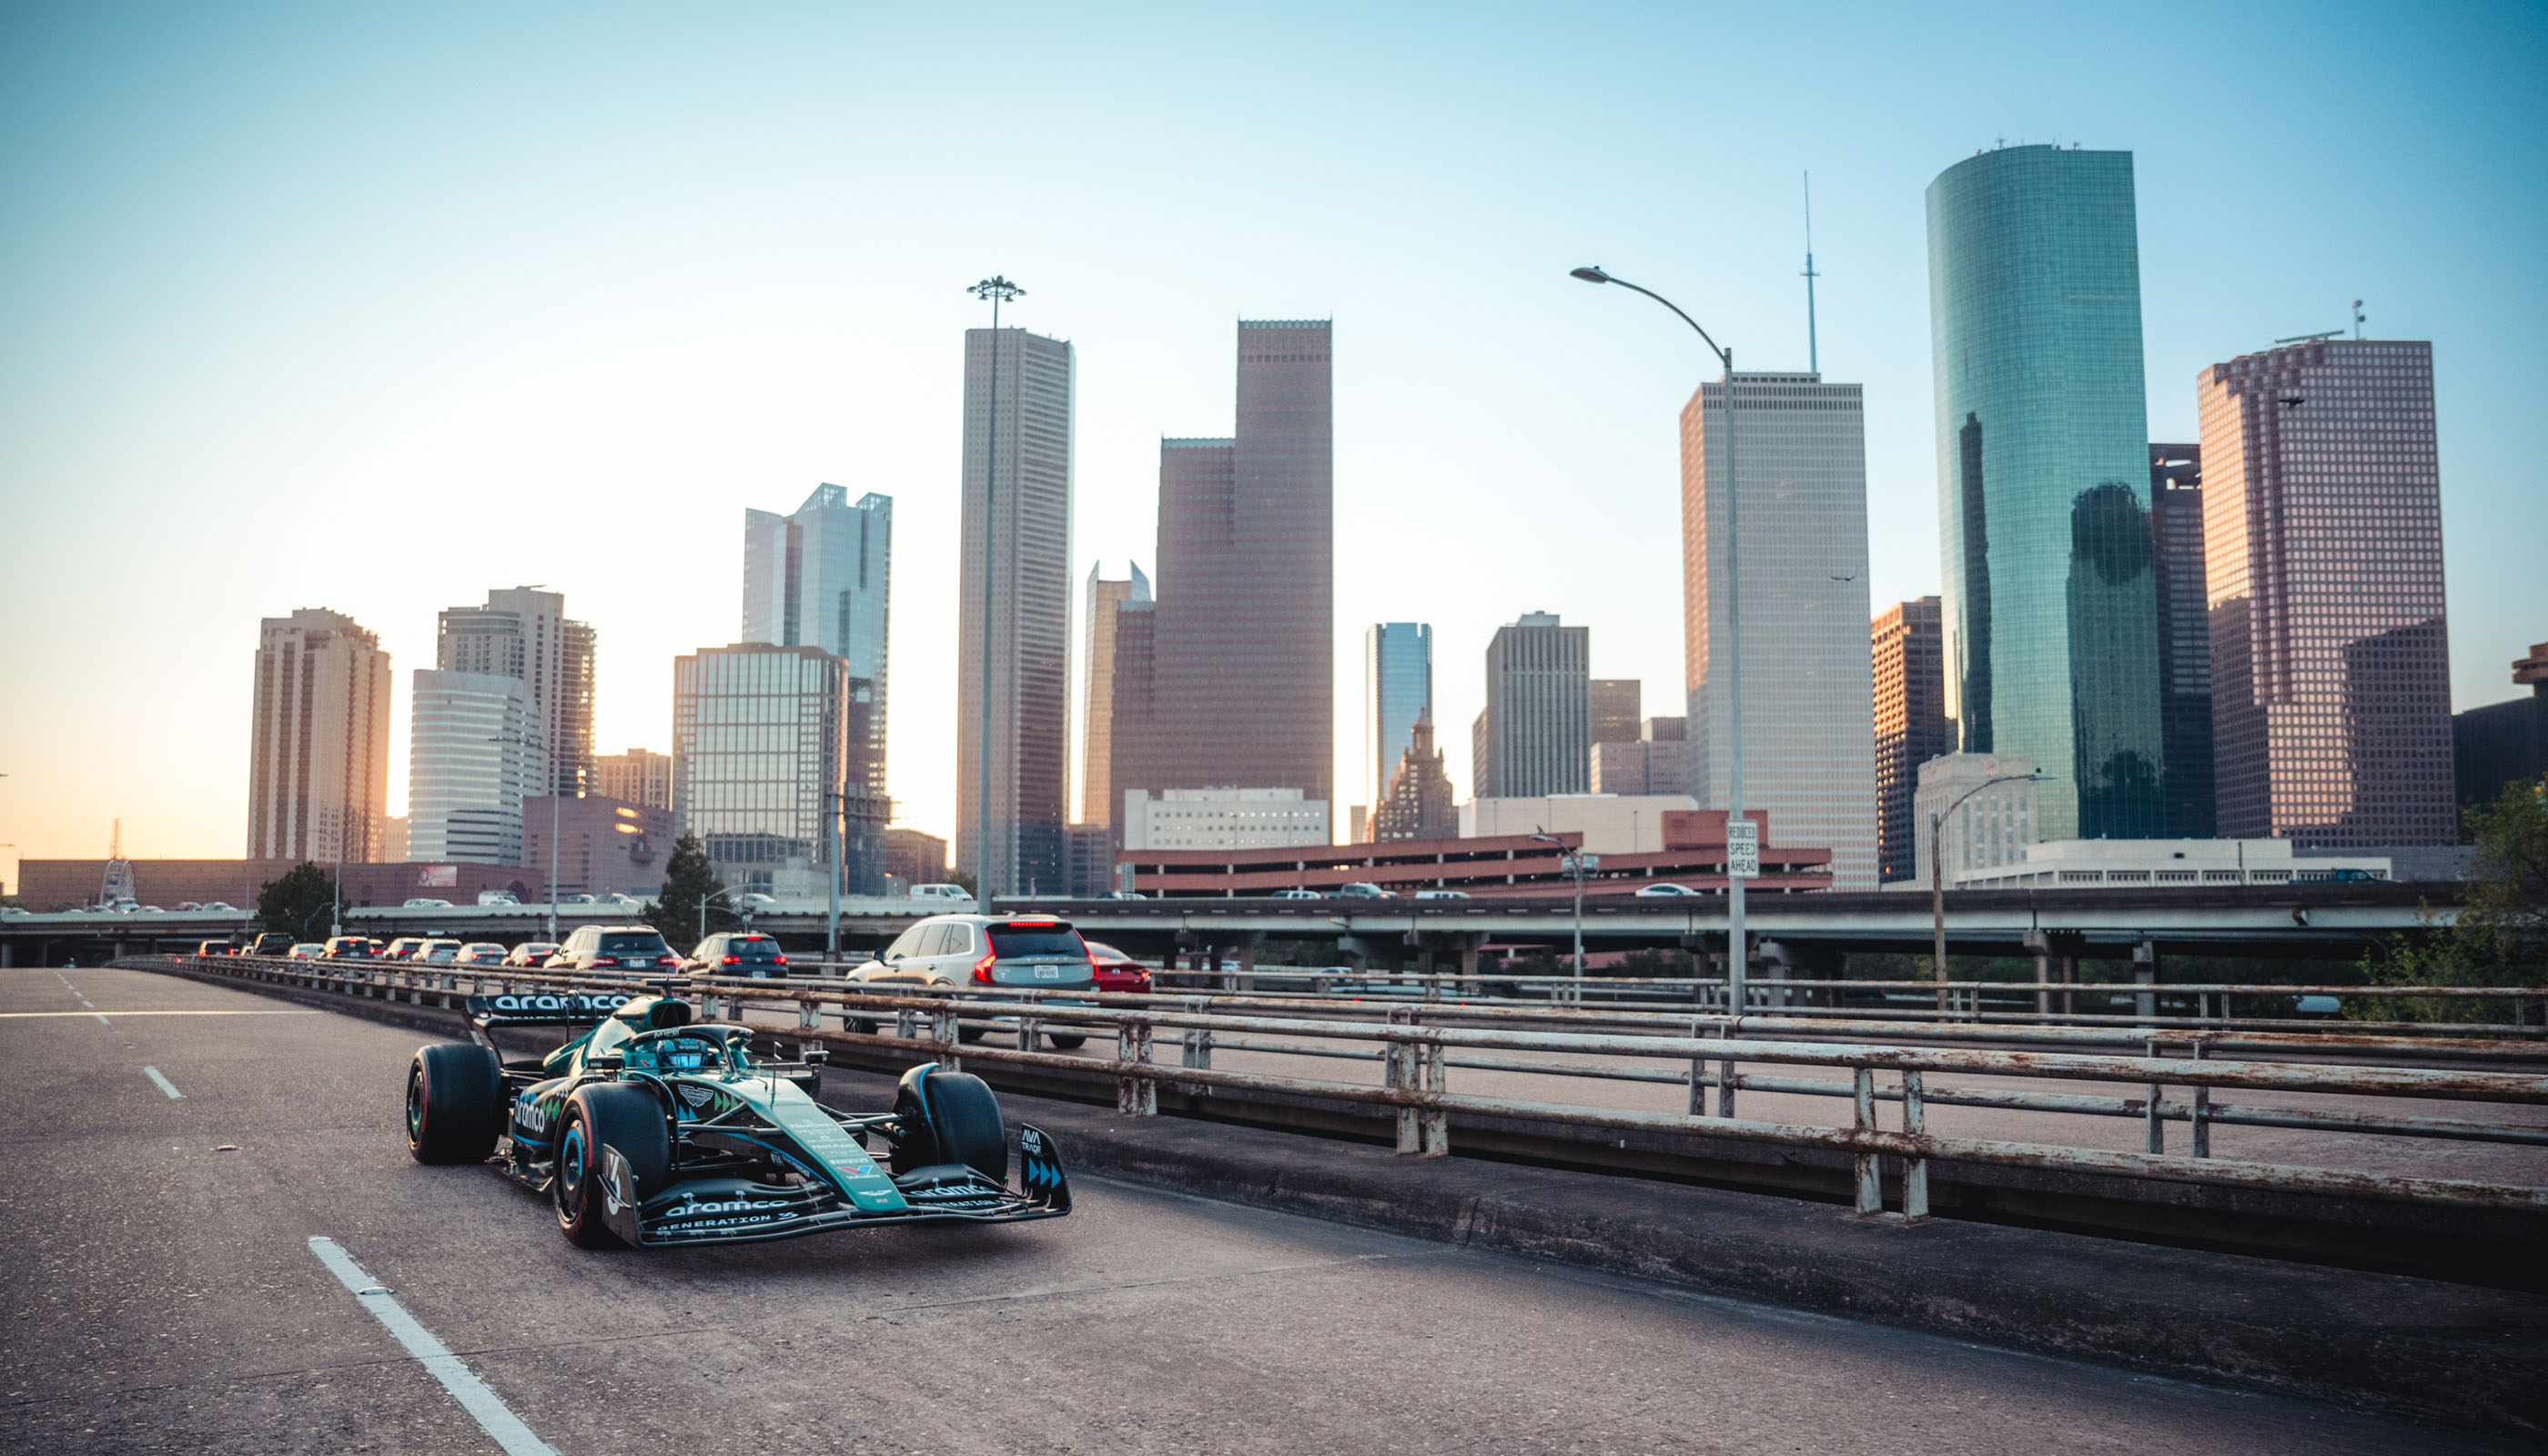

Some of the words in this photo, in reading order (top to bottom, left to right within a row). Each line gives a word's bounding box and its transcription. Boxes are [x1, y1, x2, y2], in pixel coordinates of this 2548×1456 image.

[1728, 825, 1755, 839] REDUCED
[1729, 843, 1756, 856] SPEED
[1730, 858, 1756, 873] AHEAD
[495, 995, 632, 1010] aramco
[514, 1098, 545, 1134] aramco
[1022, 1128, 1041, 1145] AVA
[1021, 1141, 1042, 1153] TRADE
[665, 1198, 790, 1218] aramco
[657, 1214, 772, 1232] GENERATION
